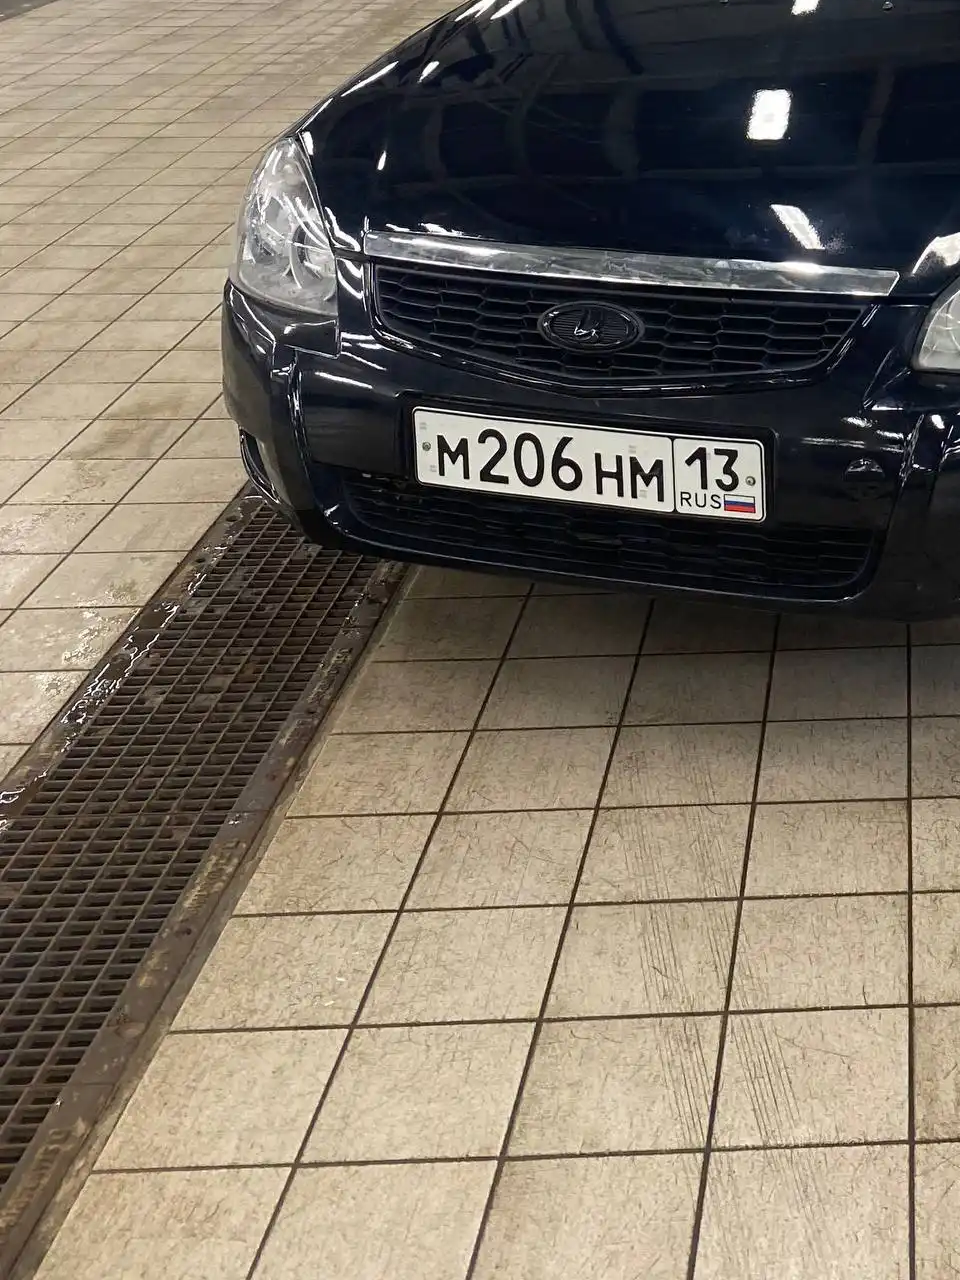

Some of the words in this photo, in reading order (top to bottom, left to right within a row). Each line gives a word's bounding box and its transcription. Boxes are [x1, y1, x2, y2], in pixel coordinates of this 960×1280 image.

[436, 428, 665, 503] М206НМ
[684, 446, 740, 493] 13
[680, 491, 722, 510] RUS
